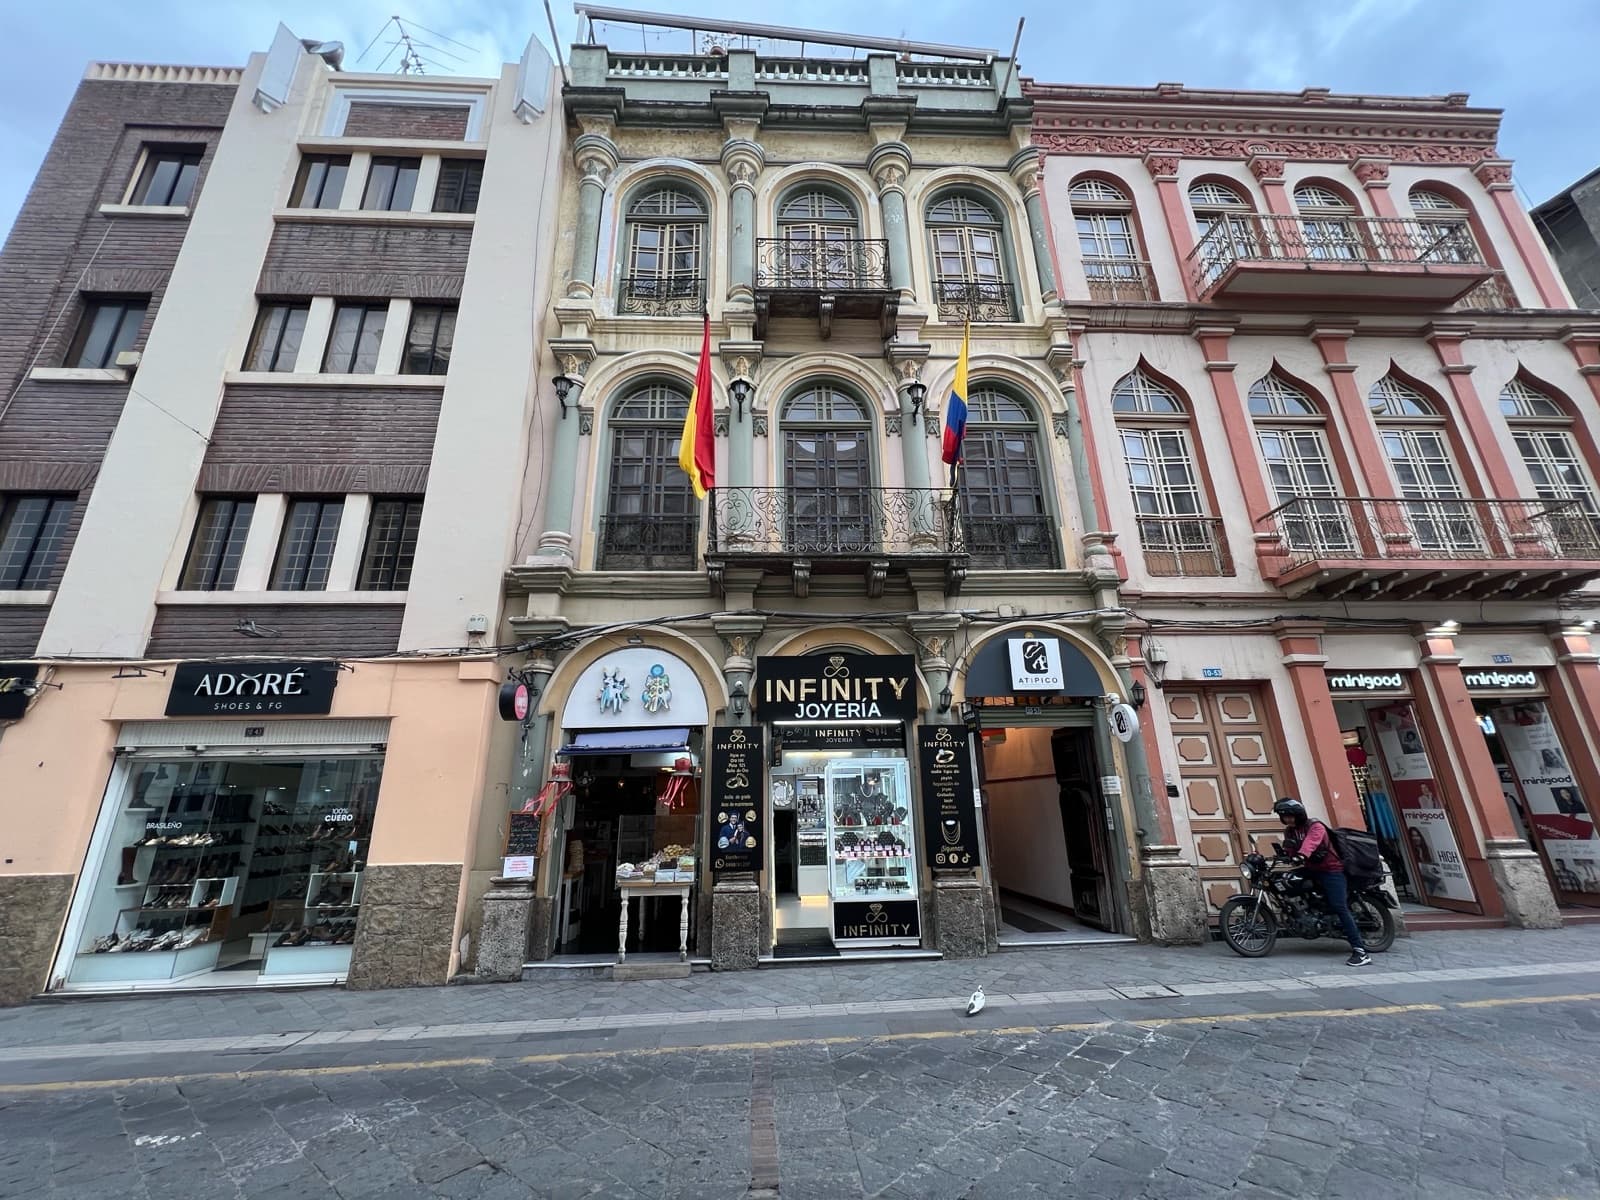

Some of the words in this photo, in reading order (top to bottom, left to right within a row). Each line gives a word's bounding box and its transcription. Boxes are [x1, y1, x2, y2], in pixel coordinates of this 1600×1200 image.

[194, 667, 305, 696] ADORÉ
[1331, 673, 1402, 689] minigood
[1465, 671, 1537, 687] minigood
[765, 677, 909, 702] INFINITY
[213, 702, 251, 711] SHOES
[255, 702, 263, 710] &
[268, 701, 283, 710] FG
[794, 697, 882, 718] JOYERÍA
[815, 729, 861, 737] INFINITY
[1522, 776, 1572, 785] minigood
[324, 814, 353, 822] CUERO
[1404, 812, 1446, 820] minigood
[1438, 850, 1460, 864] HIGH
[843, 923, 910, 937] INFINITY
